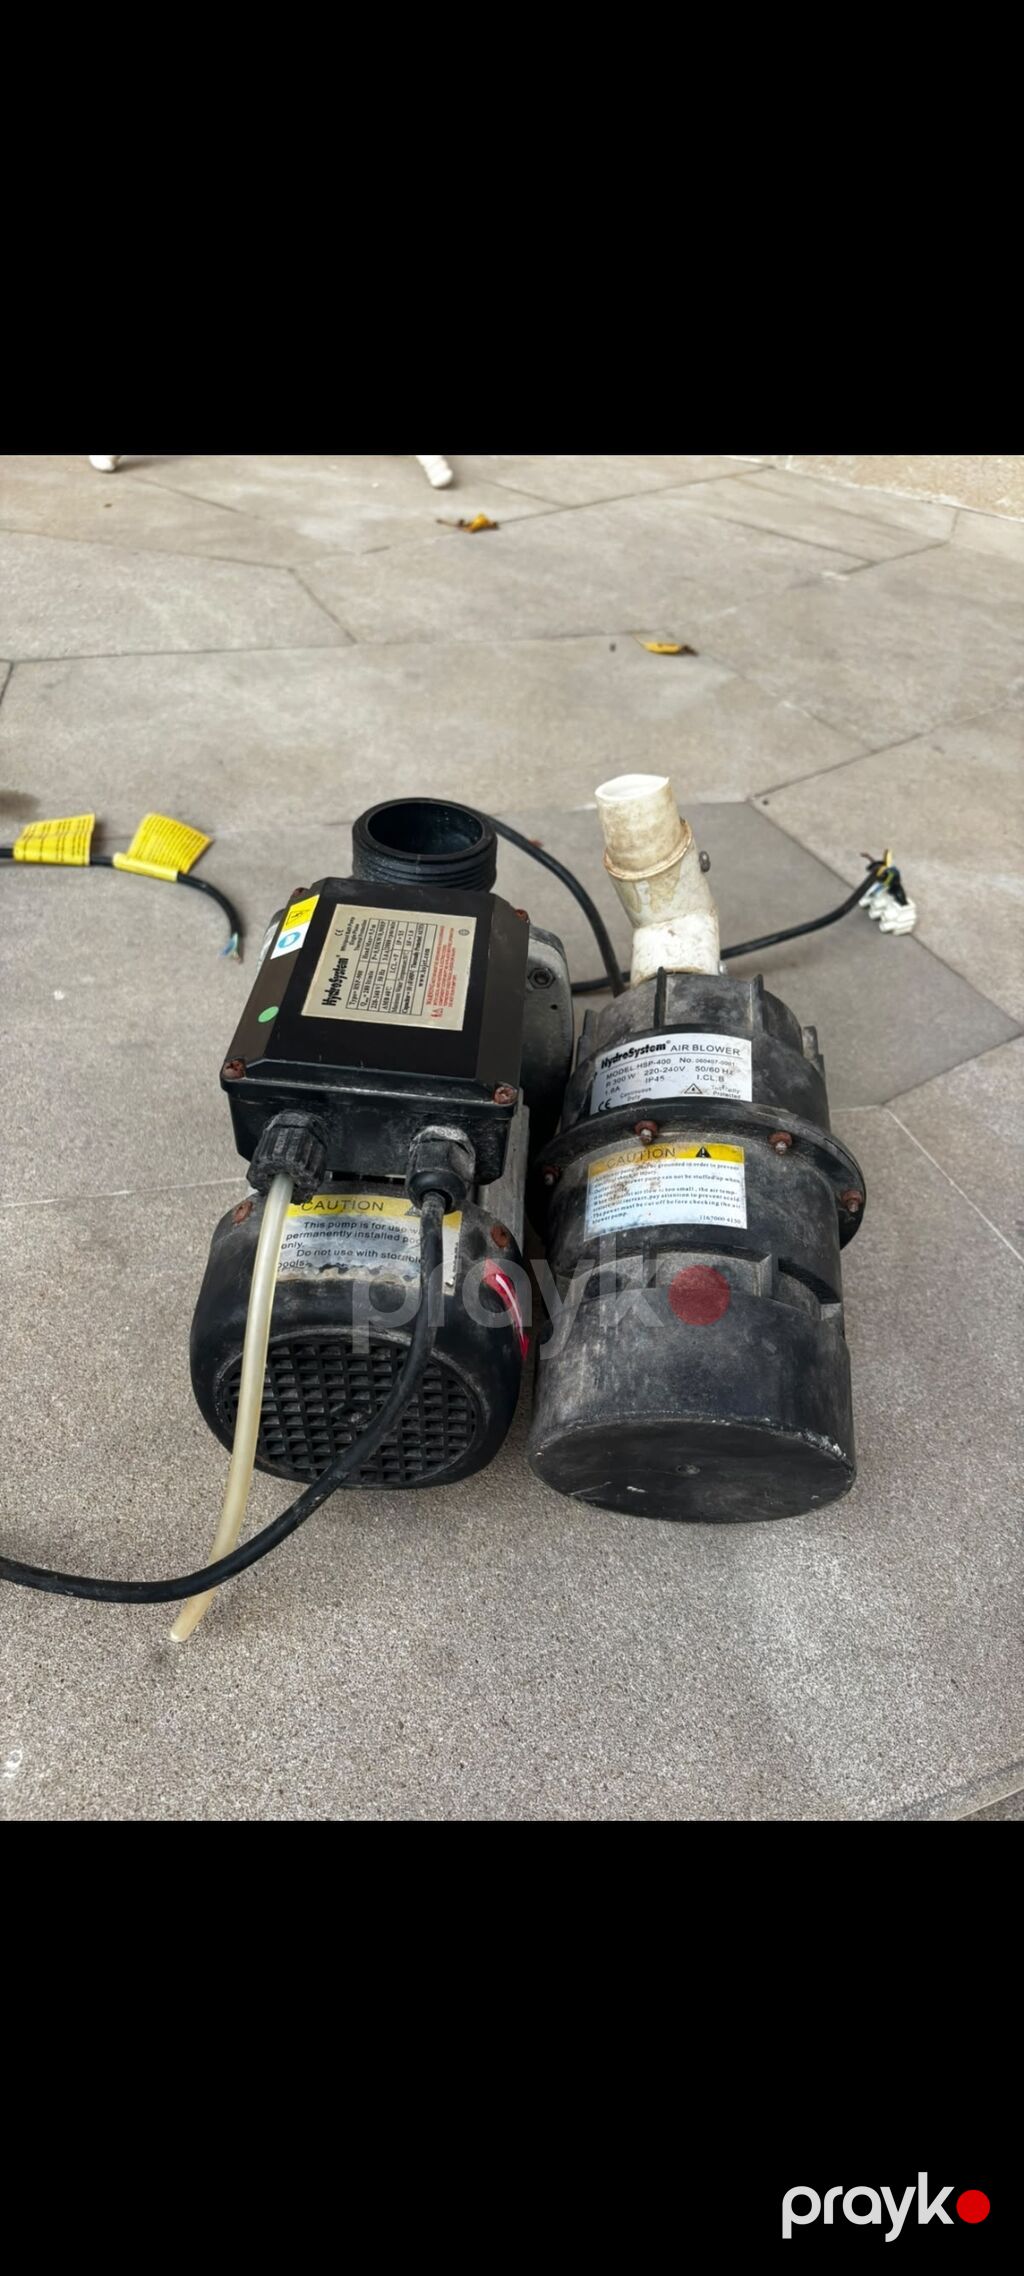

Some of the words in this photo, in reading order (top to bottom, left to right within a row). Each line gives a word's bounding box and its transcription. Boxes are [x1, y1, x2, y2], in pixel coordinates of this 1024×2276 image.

[601, 1043, 666, 1069] HydroSystem
[670, 1044, 689, 1052] AIR
[692, 1044, 741, 1056] BLOWER
[607, 1148, 675, 1168] CAUTION
[301, 1199, 384, 1211] CAUTION
[304, 1221, 325, 1229] This
[327, 1221, 357, 1230] pump
[360, 1221, 369, 1229] is
[371, 1222, 386, 1230] for
[286, 1230, 352, 1241] permanently
[354, 1231, 400, 1241] installed
[281, 1242, 305, 1250] only.
[296, 1249, 312, 1257] Do
[356, 1250, 378, 1258] with
